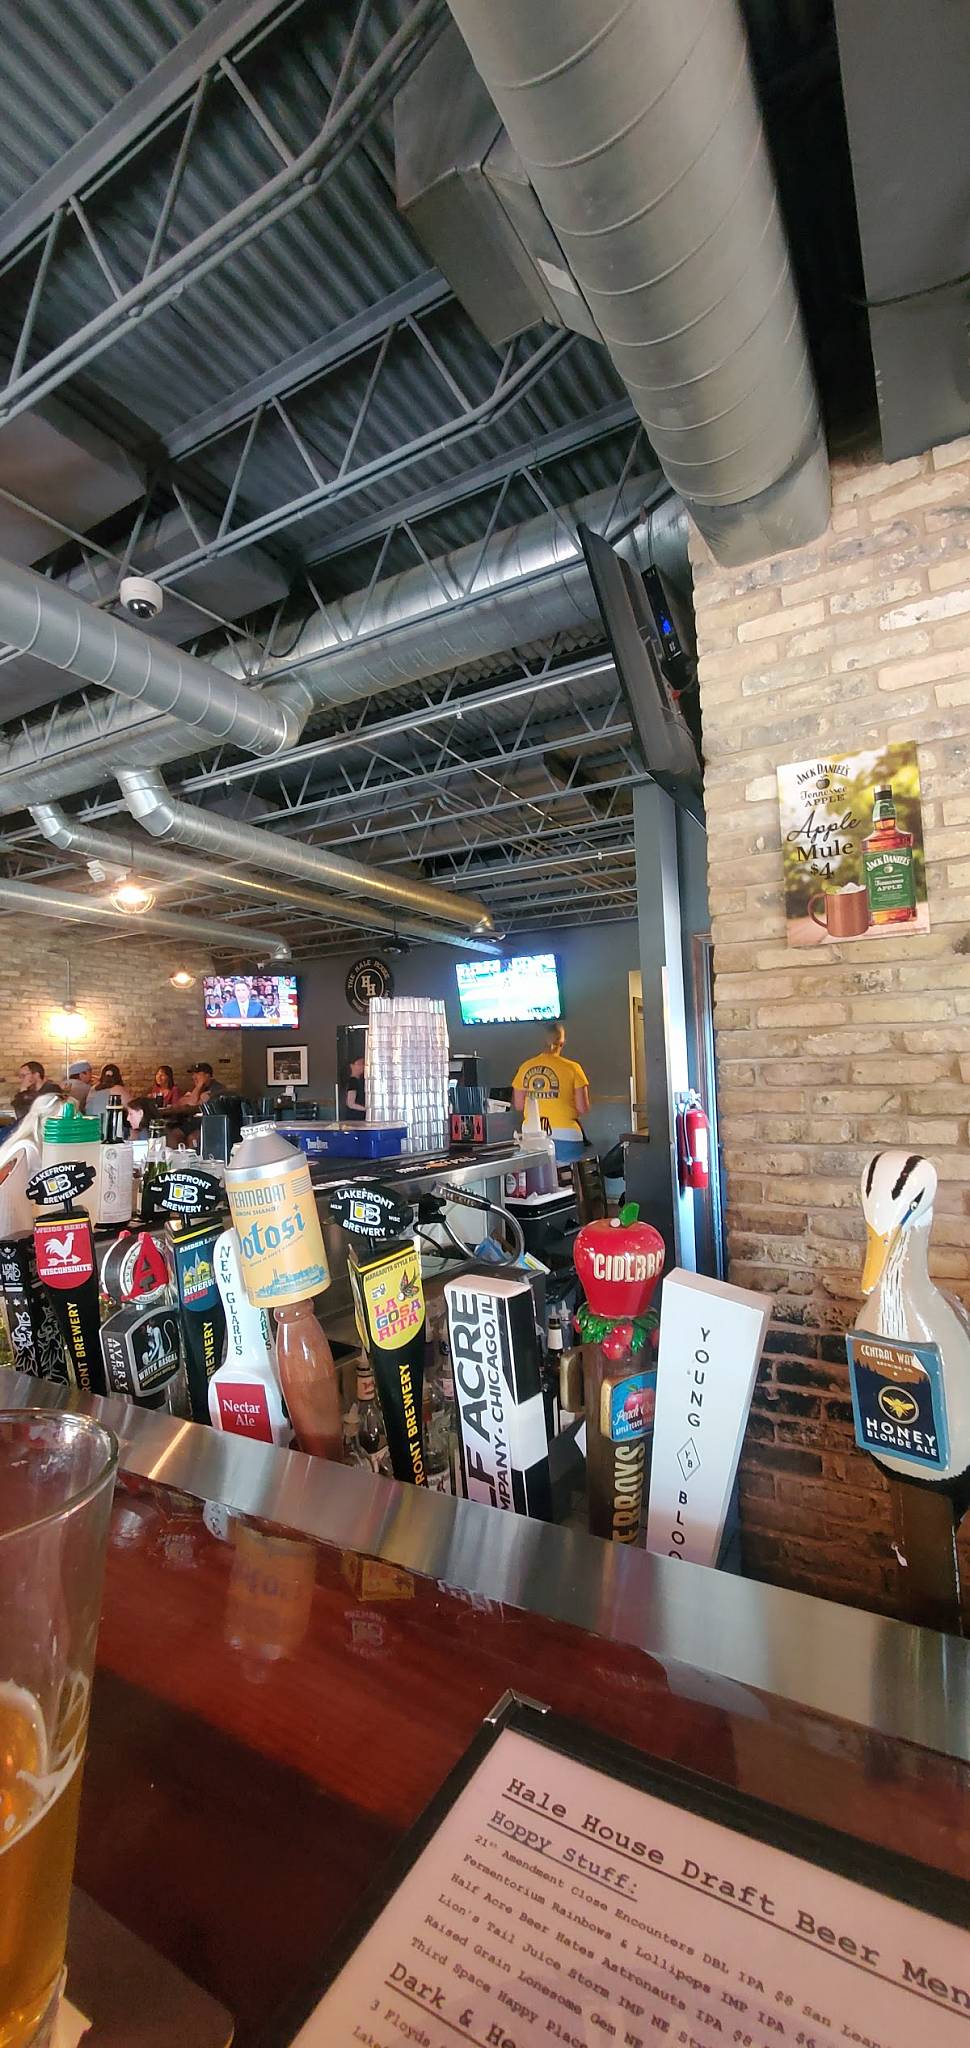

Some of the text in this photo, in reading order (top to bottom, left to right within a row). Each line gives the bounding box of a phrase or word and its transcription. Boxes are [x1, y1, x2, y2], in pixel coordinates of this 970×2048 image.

[796, 763, 851, 785] JACK DANIEL'S
[800, 786, 848, 800] Tennessee
[805, 794, 845, 807] APPLE
[787, 810, 862, 843] Apple
[796, 840, 854, 862] Mule
[866, 857, 883, 872] JACK
[810, 862, 834, 880] $4
[30, 1164, 76, 1186] LAKEFRONT
[158, 1173, 212, 1190] LAKEFRONT
[43, 1186, 79, 1204] BREWERY
[161, 1200, 202, 1213] BREWERY
[337, 1188, 395, 1210] LAKEFRONT
[240, 1212, 305, 1259] otosi
[342, 1219, 386, 1237] BREWERY
[40, 1263, 93, 1276] WISCONSINITE
[219, 1245, 243, 1356] NEW GLARUS
[374, 1298, 397, 1317] LA
[376, 1299, 421, 1330] GOSA
[67, 1302, 86, 1358] BREWERY
[378, 1312, 419, 1341] RITA
[112, 1338, 128, 1391] AVERY
[450, 1290, 491, 1443] ACRE
[860, 1344, 895, 1362] CENTRAL
[138, 1362, 158, 1381] WHITE
[687, 1327, 711, 1428] YOUNG
[222, 1399, 260, 1415] Nectar
[398, 1363, 417, 1438] BREWERY
[235, 1412, 255, 1428] Ale
[866, 1417, 935, 1447] HONEY
[867, 1430, 937, 1457] BLONDE ALE
[490, 1810, 638, 1895] Hoppy Stuff:
[506, 1777, 567, 1818] Hale
[581, 1814, 664, 1865] House
[681, 1859, 775, 1915] Draft
[795, 1910, 880, 1966] Beer
[451, 1873, 480, 1895] Half
[483, 1892, 513, 1914] Acre
[519, 1912, 549, 1934] Beer
[555, 1932, 595, 1959] Hates
[602, 1957, 686, 2010] Astronauts
[696, 2010, 722, 2031] IPA
[463, 1854, 546, 1905] Fermentorium
[551, 1902, 612, 1940] Rainbows
[620, 1939, 628, 1949] &
[635, 1945, 711, 1994] Lollipops
[721, 1991, 748, 2013] IMP
[758, 2011, 785, 2035] IPA
[502, 1850, 565, 1888] Amendment
[570, 1886, 608, 1911] Close
[614, 1908, 695, 1955] Encounters
[703, 1953, 730, 1975] DBL
[738, 1971, 765, 1993] IPA
[802, 2006, 831, 2027] San
[424, 1914, 469, 1947] Raised
[473, 1945, 512, 1973] Grain
[517, 1970, 583, 2015] Lonesome
[590, 2012, 617, 2036] Gem
[438, 1894, 480, 1923] Lion's
[487, 1922, 515, 1944] Tail
[522, 1944, 561, 1970] Juice
[568, 1968, 610, 1998] Storm
[618, 1995, 645, 2017] IMP
[651, 2015, 670, 2033] NE
[389, 1962, 446, 2009] Dark
[459, 2009, 474, 2028] &
[410, 1937, 448, 1966] Third
[452, 1963, 491, 1993] Space
[497, 1990, 539, 2024] Happy
[370, 2000, 430, 2048] 3 Floyds
